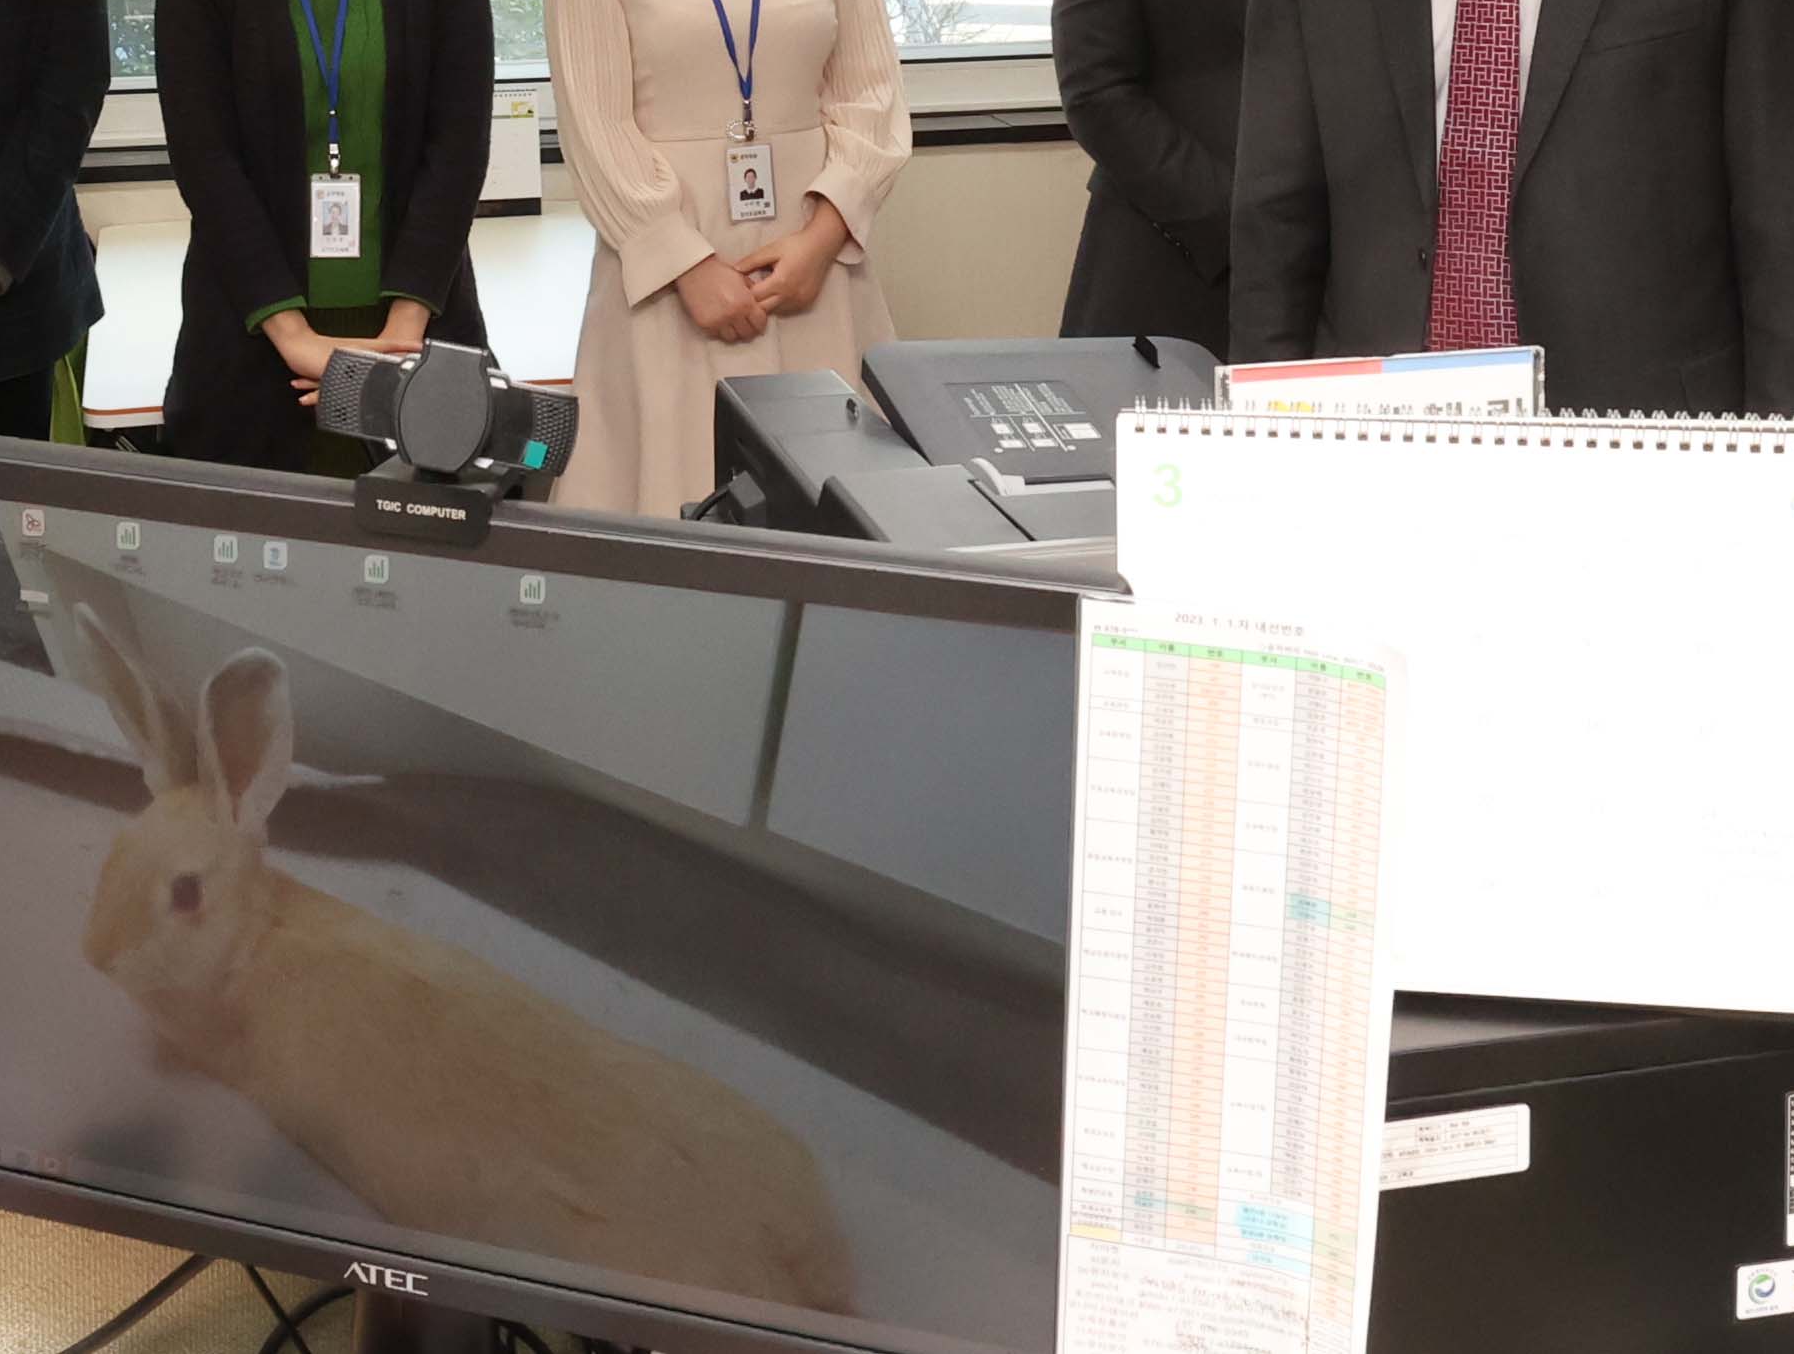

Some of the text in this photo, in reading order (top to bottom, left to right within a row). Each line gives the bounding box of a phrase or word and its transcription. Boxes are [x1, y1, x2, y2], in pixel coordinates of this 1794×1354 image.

[1152, 463, 1184, 509] 3
[406, 503, 466, 520] COMPUTER
[344, 1261, 429, 1296] ATEC
